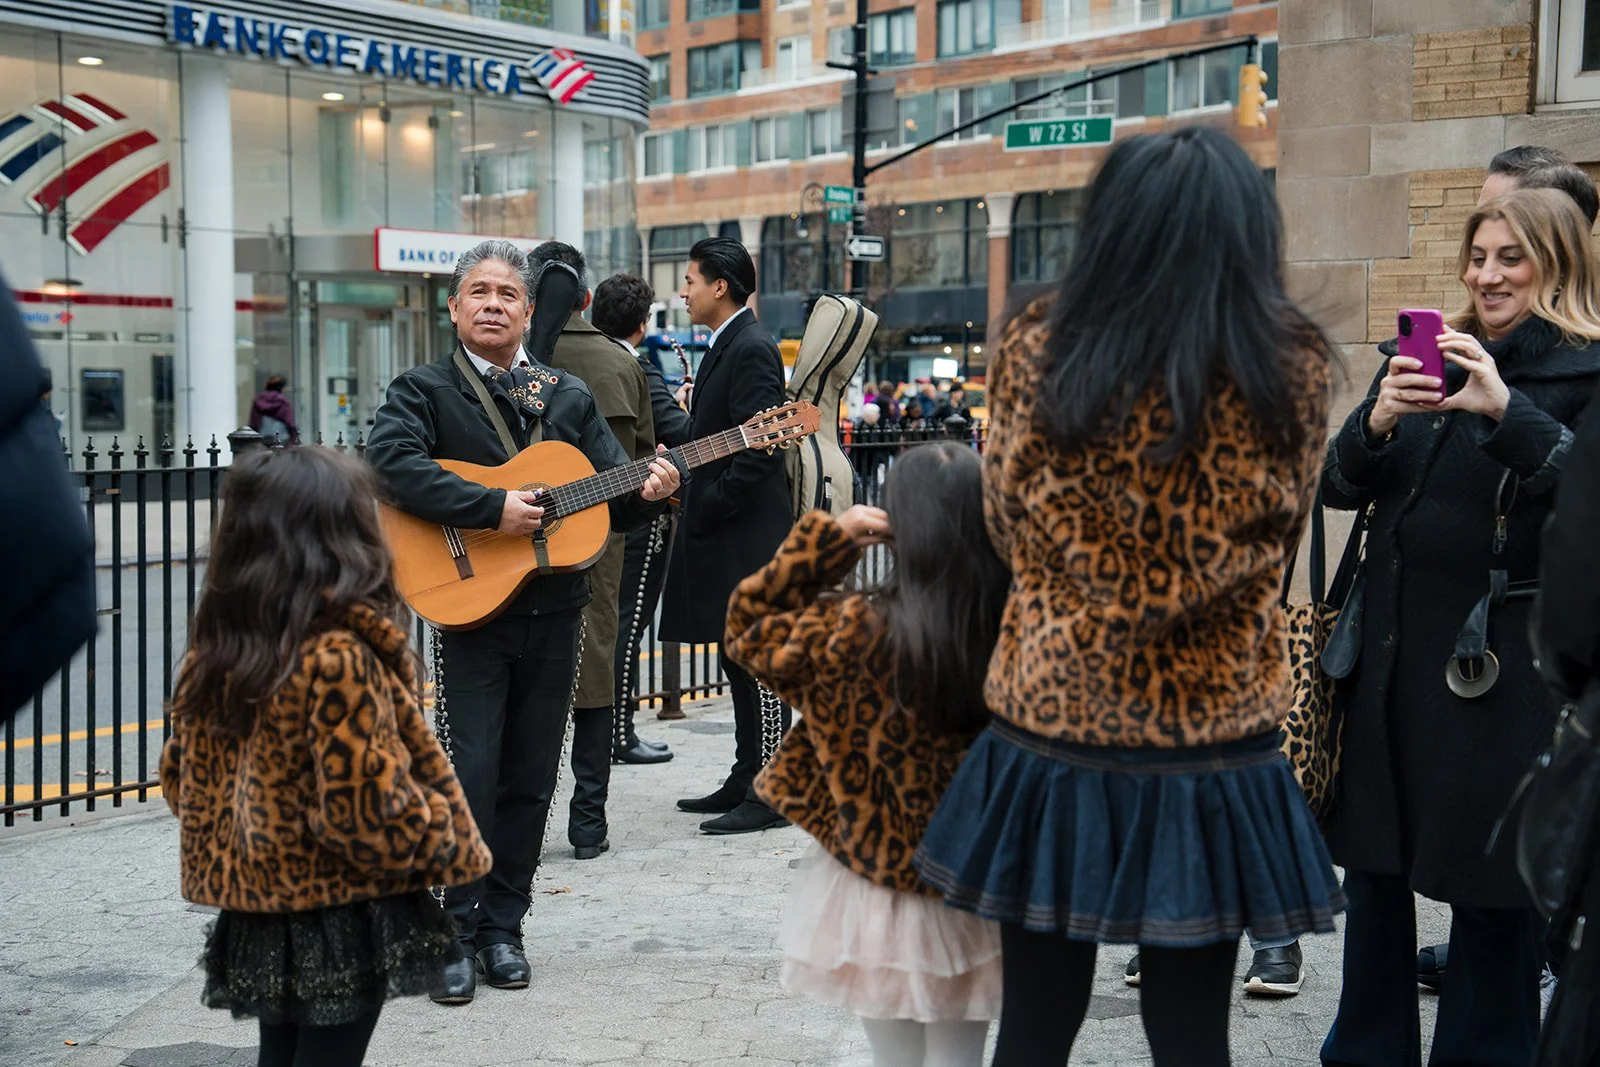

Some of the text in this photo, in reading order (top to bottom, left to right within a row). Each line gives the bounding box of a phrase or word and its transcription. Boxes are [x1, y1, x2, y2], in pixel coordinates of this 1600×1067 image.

[173, 5, 525, 95] BANK OF AMERICA
[1029, 122, 1087, 144] W 72 St
[399, 248, 435, 263] BANK
[439, 252, 456, 264] OF
